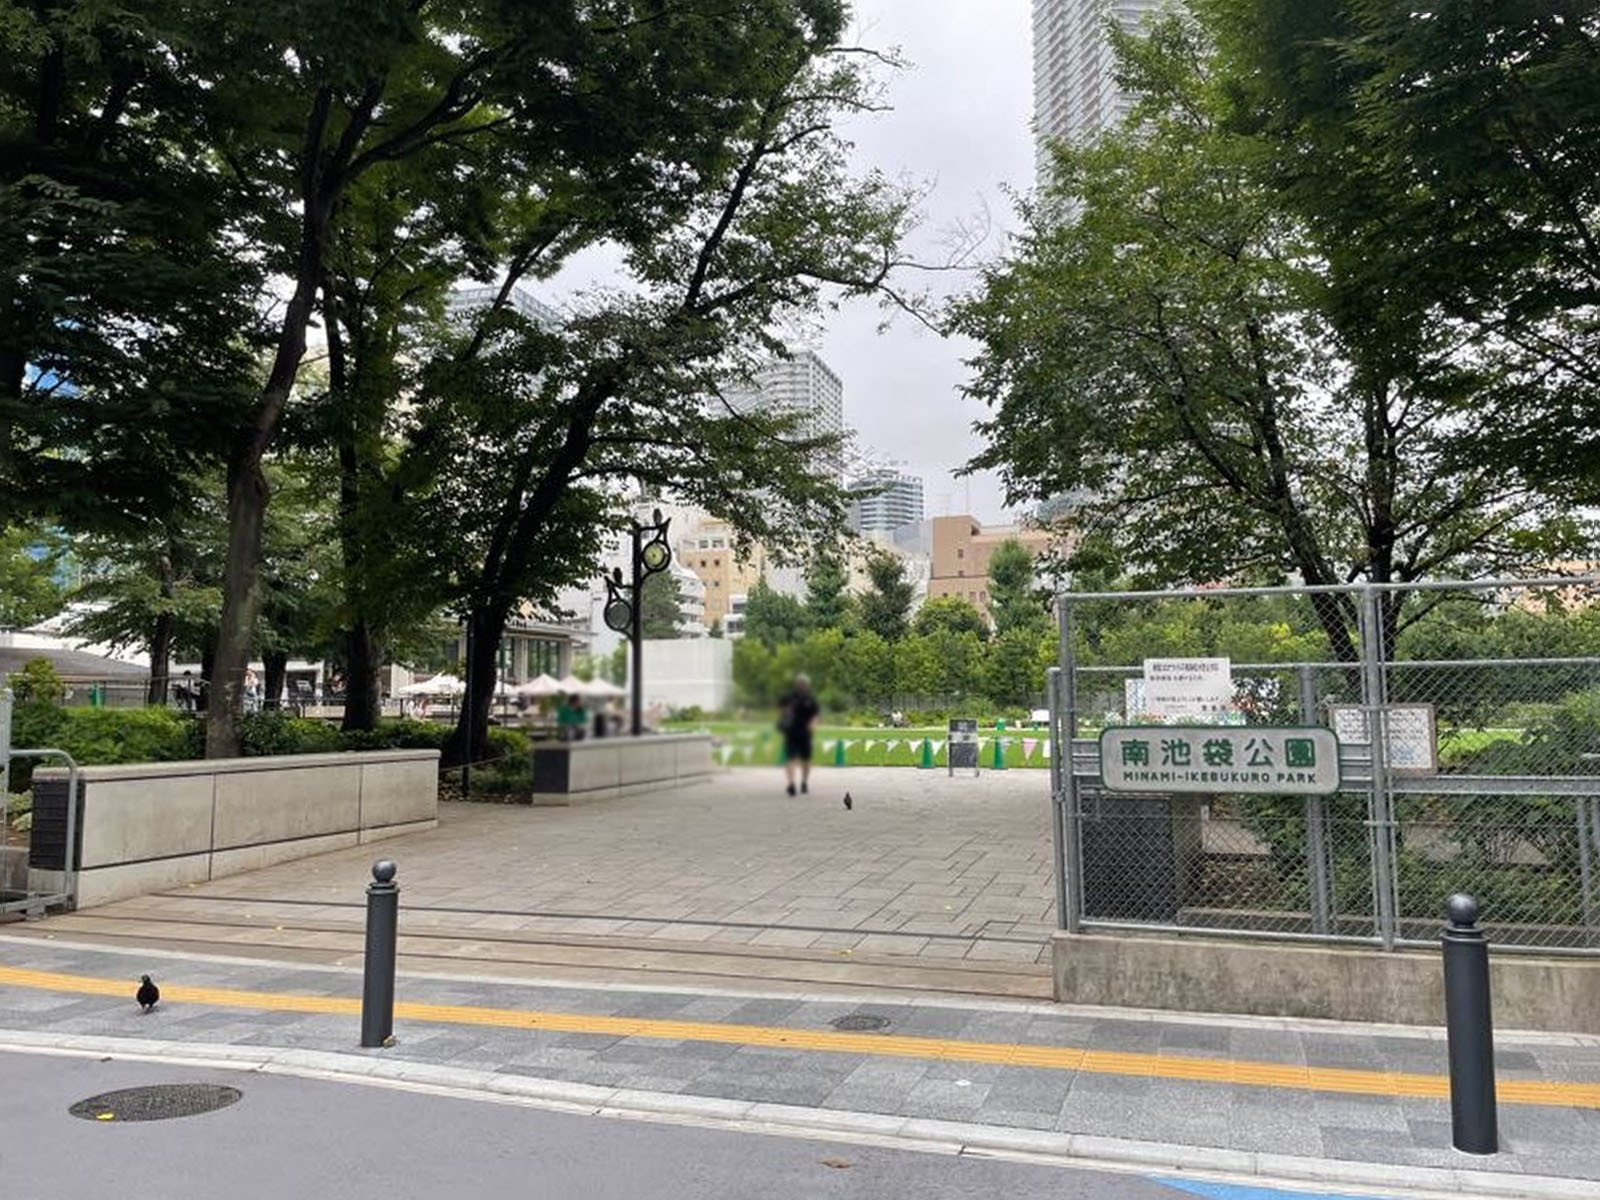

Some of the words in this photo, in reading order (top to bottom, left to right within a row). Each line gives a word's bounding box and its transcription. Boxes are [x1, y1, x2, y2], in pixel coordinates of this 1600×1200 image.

[1120, 738, 1316, 767] 南池袋公園
[1123, 771, 1270, 783] MINAMI-IKEBUKURO
[1276, 772, 1316, 783] PARK
